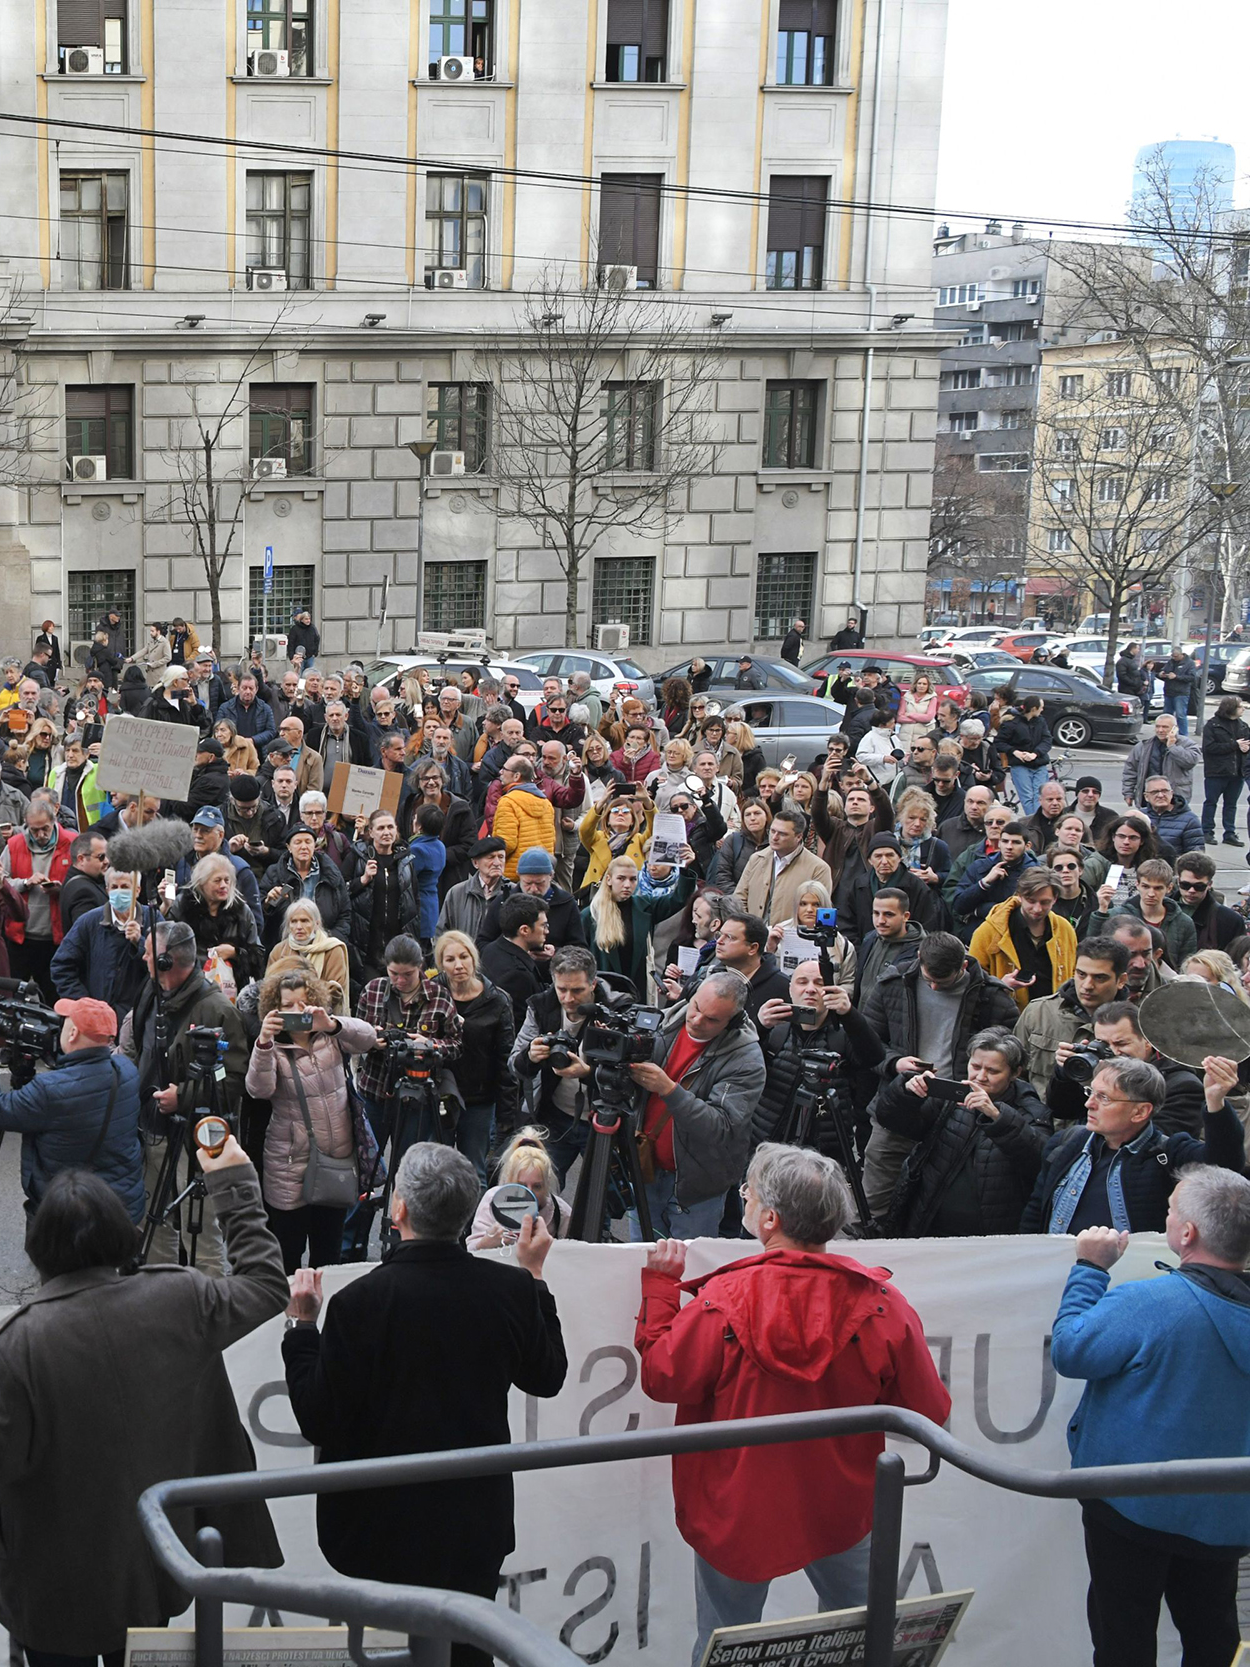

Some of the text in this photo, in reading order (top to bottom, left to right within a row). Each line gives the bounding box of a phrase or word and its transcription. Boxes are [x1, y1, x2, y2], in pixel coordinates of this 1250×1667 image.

[116, 720, 143, 736] НЕМА
[132, 738, 151, 753] БЕЗ
[124, 755, 165, 772] СЛОБОДЕ
[120, 771, 139, 784] БЕЗ
[765, 1640, 806, 1657] nove
[809, 1629, 866, 1649] italijan
[271, 1650, 309, 1660] PROTEST
[312, 1650, 325, 1660] NA
[326, 1649, 351, 1659] ULICA
[802, 1648, 850, 1666] Crnoj
